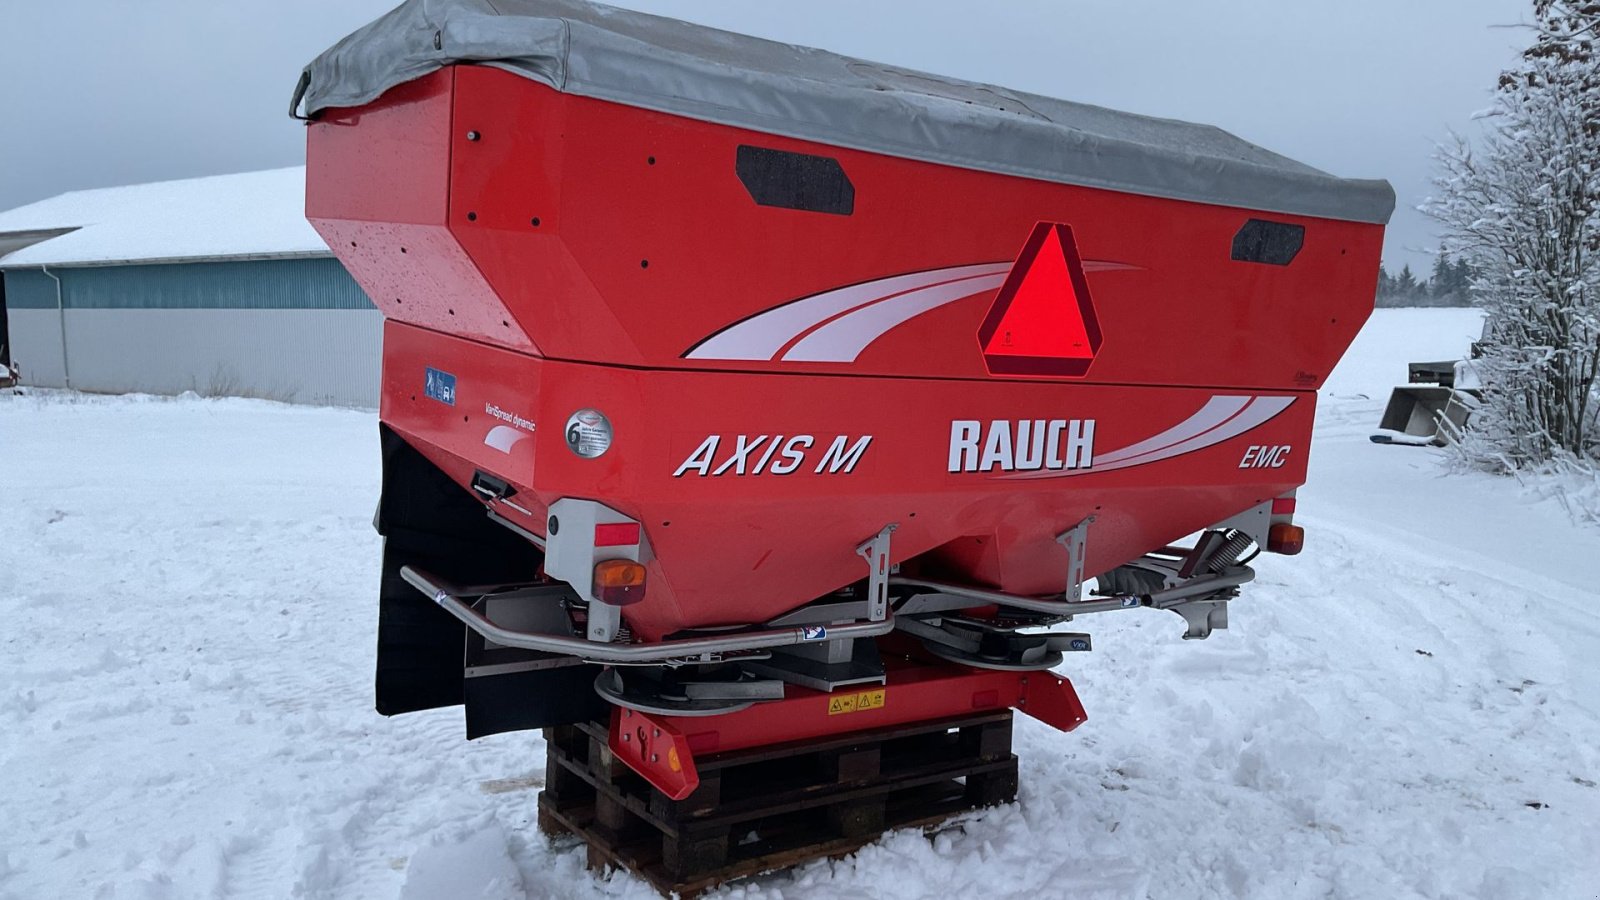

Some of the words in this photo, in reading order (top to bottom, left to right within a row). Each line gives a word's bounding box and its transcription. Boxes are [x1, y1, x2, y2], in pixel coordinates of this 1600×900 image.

[513, 413, 536, 431] dynamic
[568, 422, 580, 444] 6
[672, 435, 815, 477] AXIS
[813, 435, 874, 475] M
[947, 419, 1096, 473] RAUCH
[1238, 445, 1292, 468] EMC
